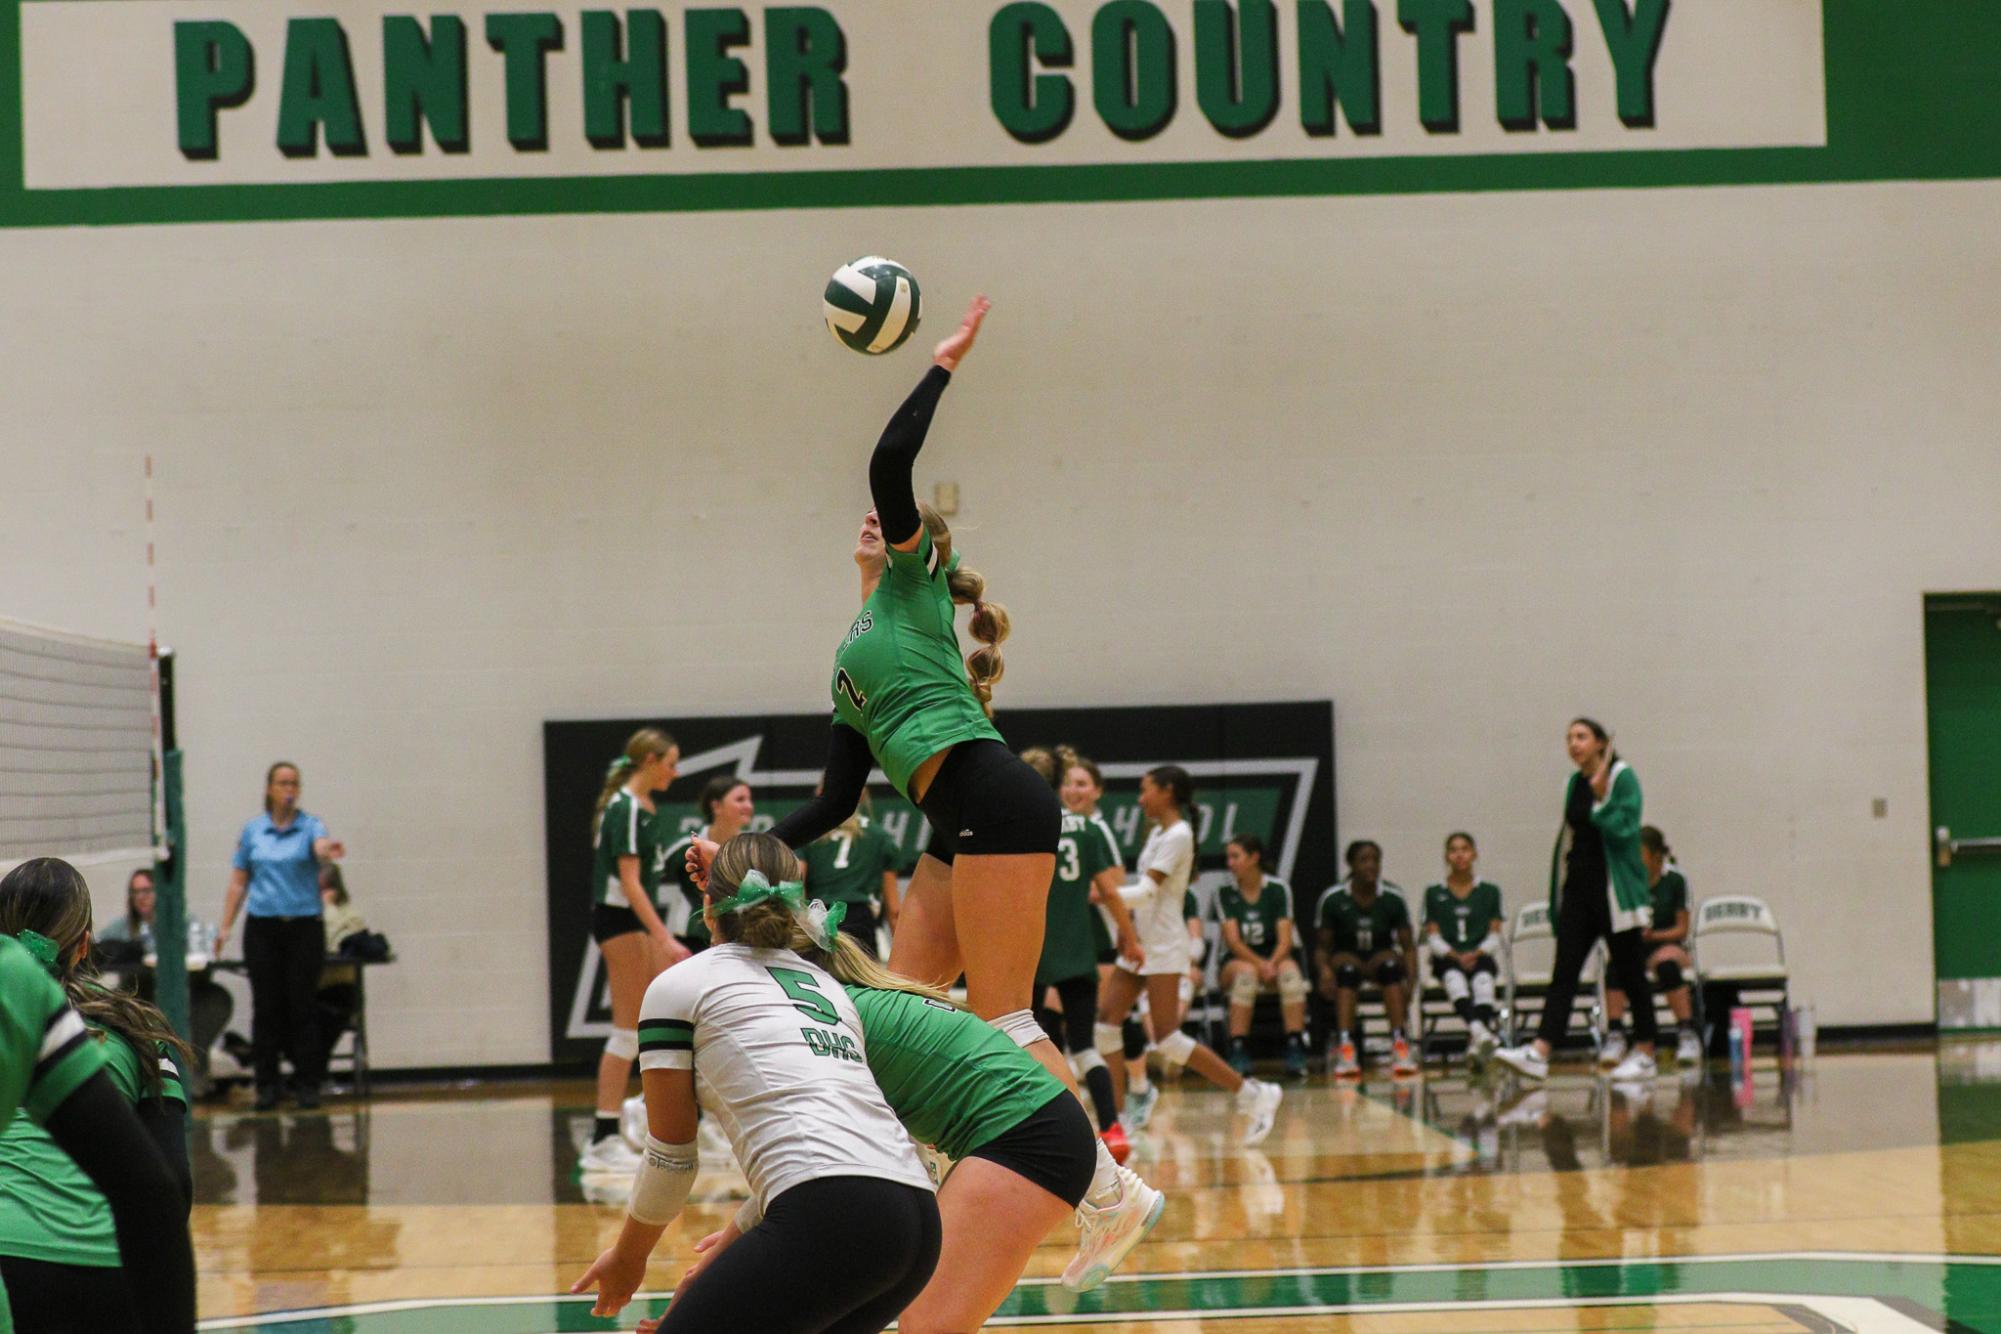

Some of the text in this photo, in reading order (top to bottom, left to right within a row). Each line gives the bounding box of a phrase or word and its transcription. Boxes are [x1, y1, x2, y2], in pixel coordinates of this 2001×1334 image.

[173, 0, 1672, 161] PANTHER COUNTRY
[831, 829, 851, 869] 7
[1057, 837, 1081, 882] 3
[1241, 921, 1265, 945] 12
[1457, 918, 1468, 942] 1
[765, 965, 842, 1026] 5
